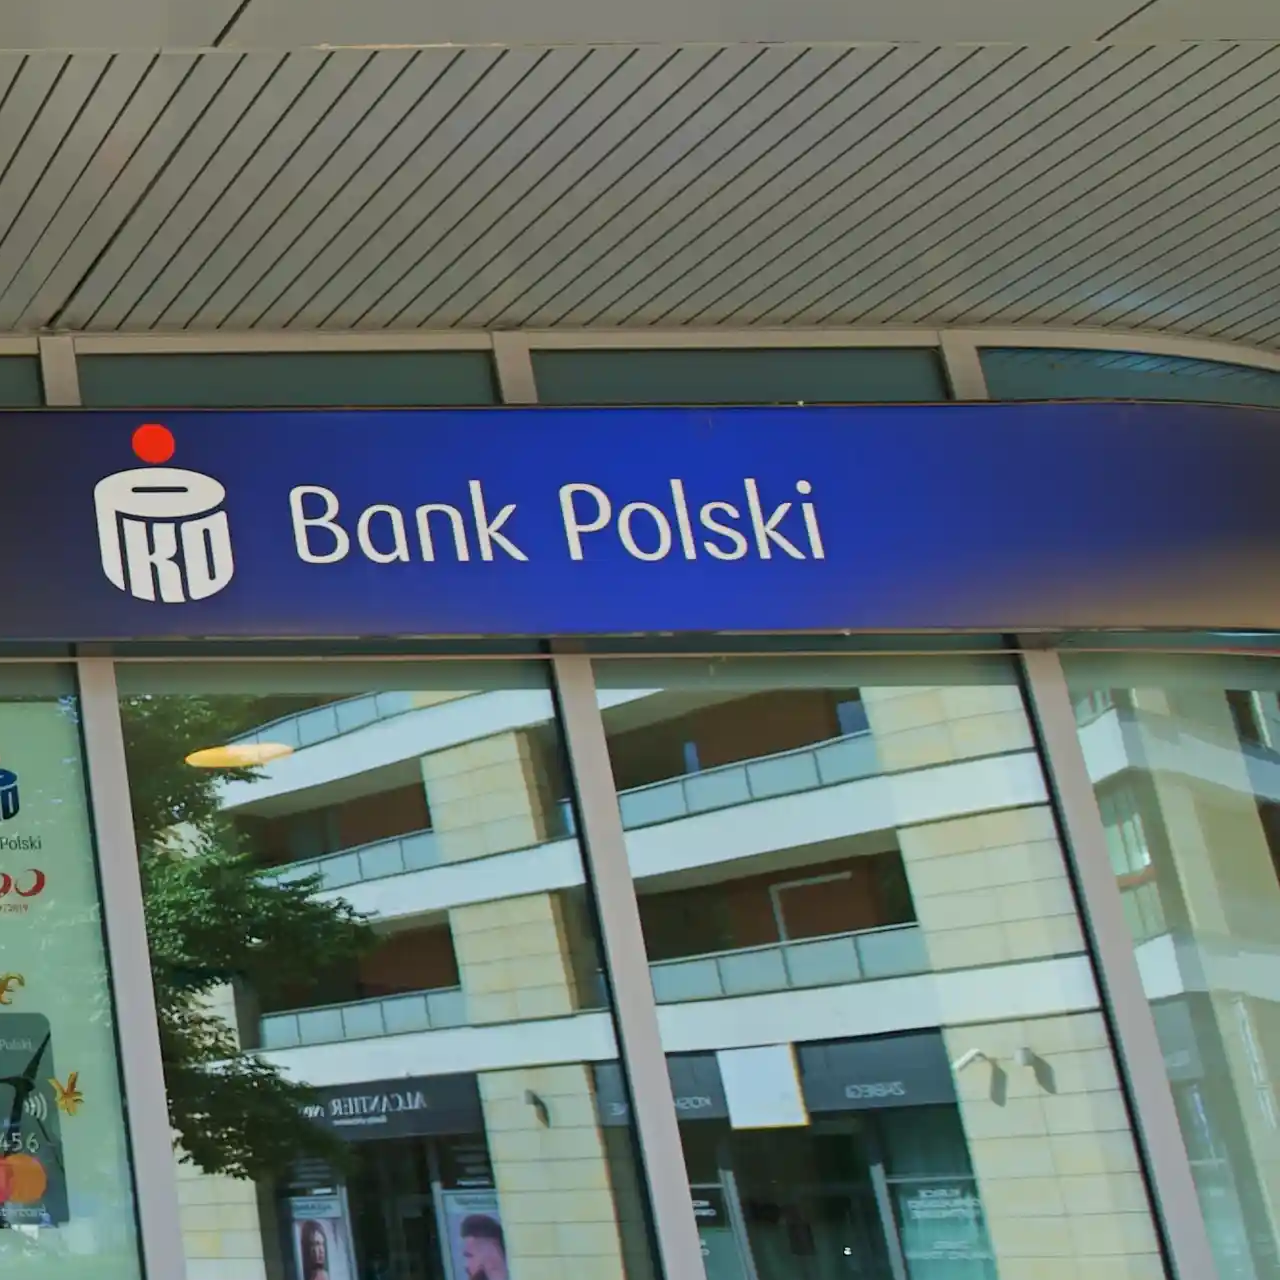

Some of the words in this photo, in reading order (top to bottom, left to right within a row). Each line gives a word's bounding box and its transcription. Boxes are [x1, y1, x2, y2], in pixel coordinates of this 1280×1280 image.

[290, 479, 529, 564] Bank
[559, 477, 825, 562] Polski
[0, 835, 42, 851] Polski
